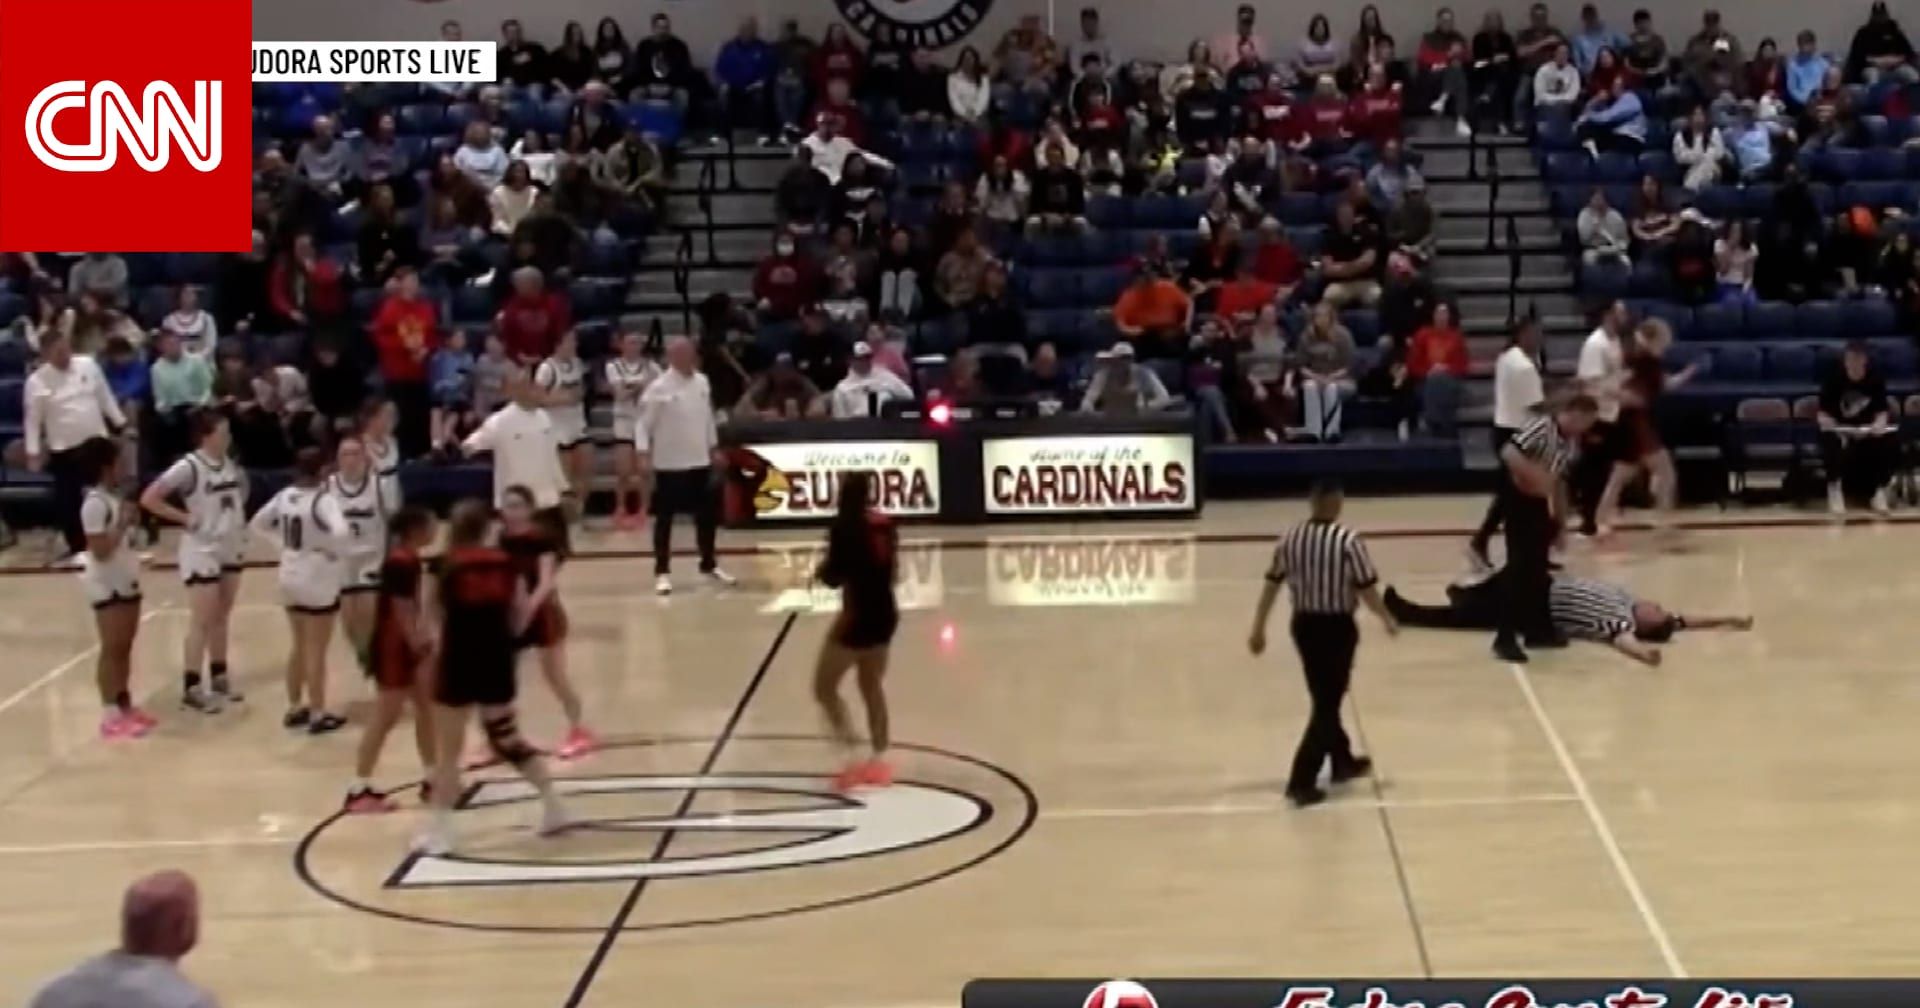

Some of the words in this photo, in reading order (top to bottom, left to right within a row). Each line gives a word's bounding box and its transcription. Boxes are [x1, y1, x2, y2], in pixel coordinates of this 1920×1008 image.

[846, 2, 978, 47] CADINALS
[786, 468, 935, 510] EUORA
[992, 462, 1187, 507] CARDINALS
